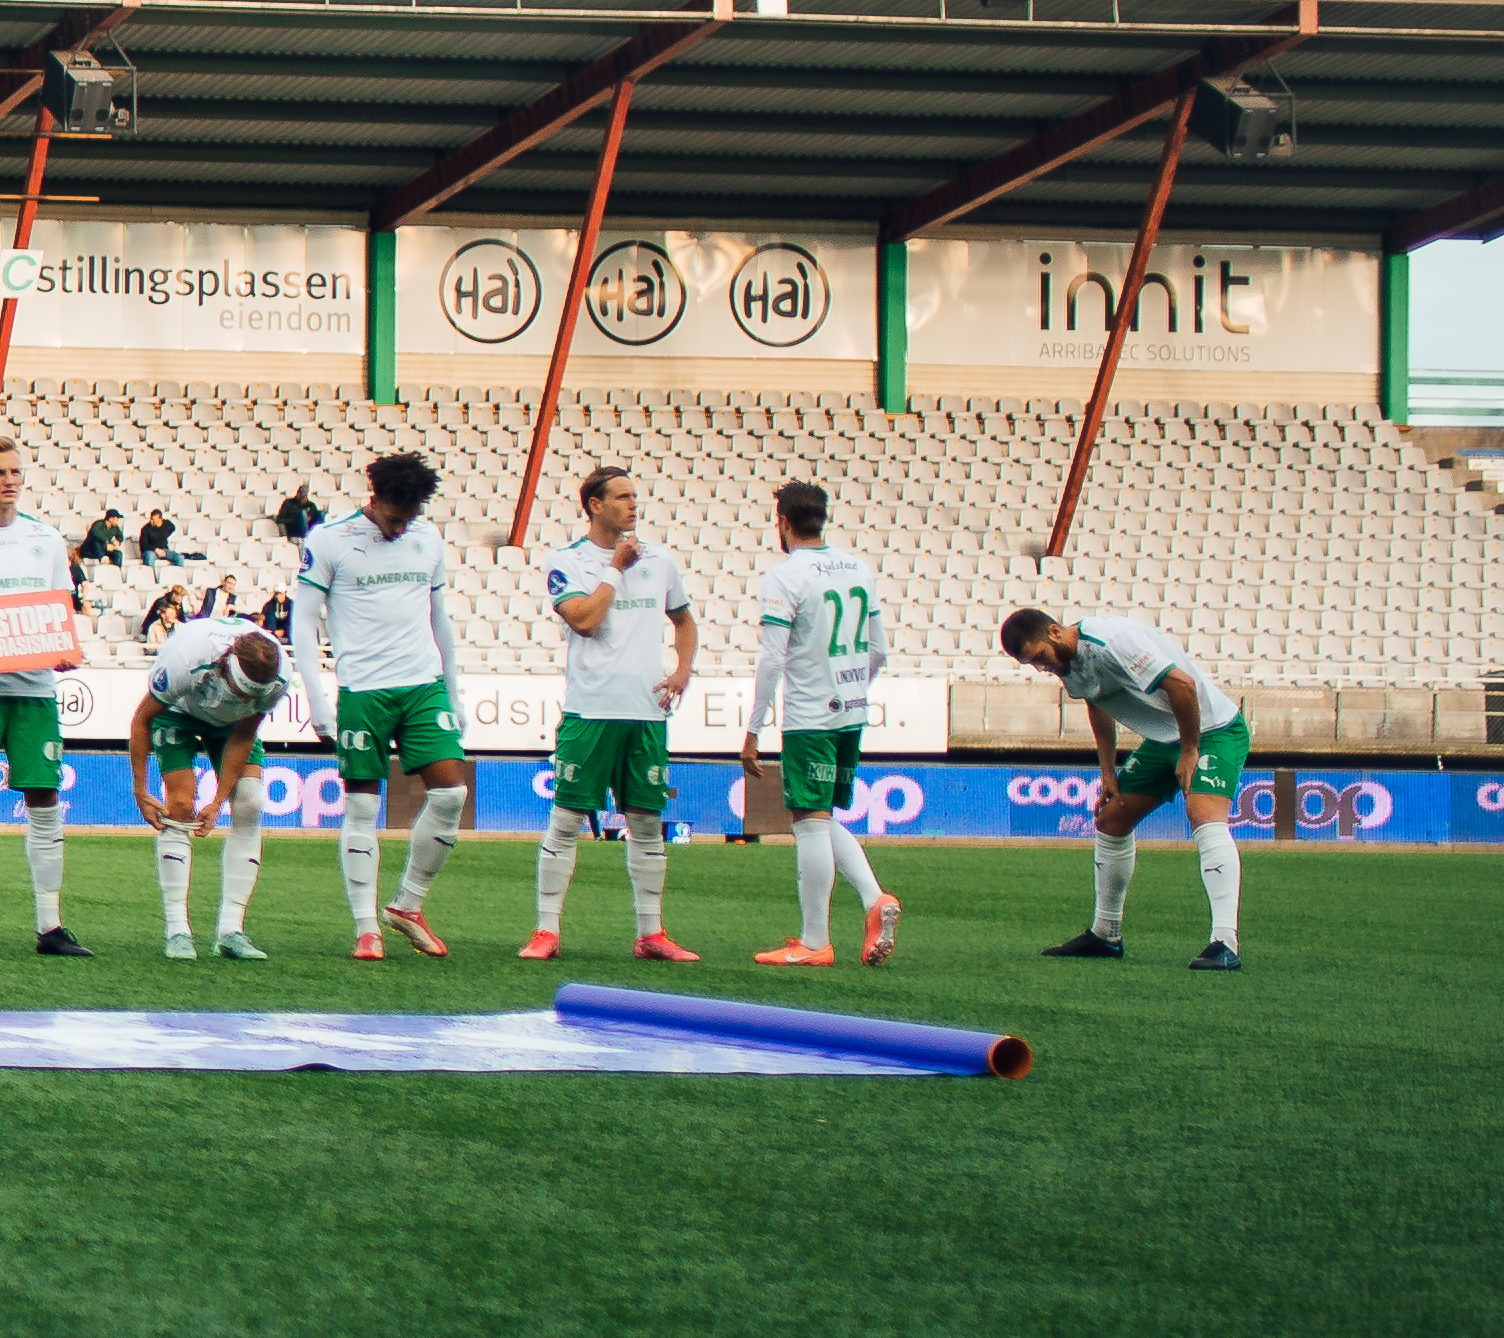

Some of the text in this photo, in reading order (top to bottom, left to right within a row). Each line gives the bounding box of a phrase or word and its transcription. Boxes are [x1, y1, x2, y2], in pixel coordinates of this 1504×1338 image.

[2, 254, 37, 292] C
[1040, 252, 1251, 335] innit
[219, 304, 352, 332] eiendom
[1039, 342, 1251, 362] ARRIBAEC SOLUTIONS
[823, 585, 869, 657] 22
